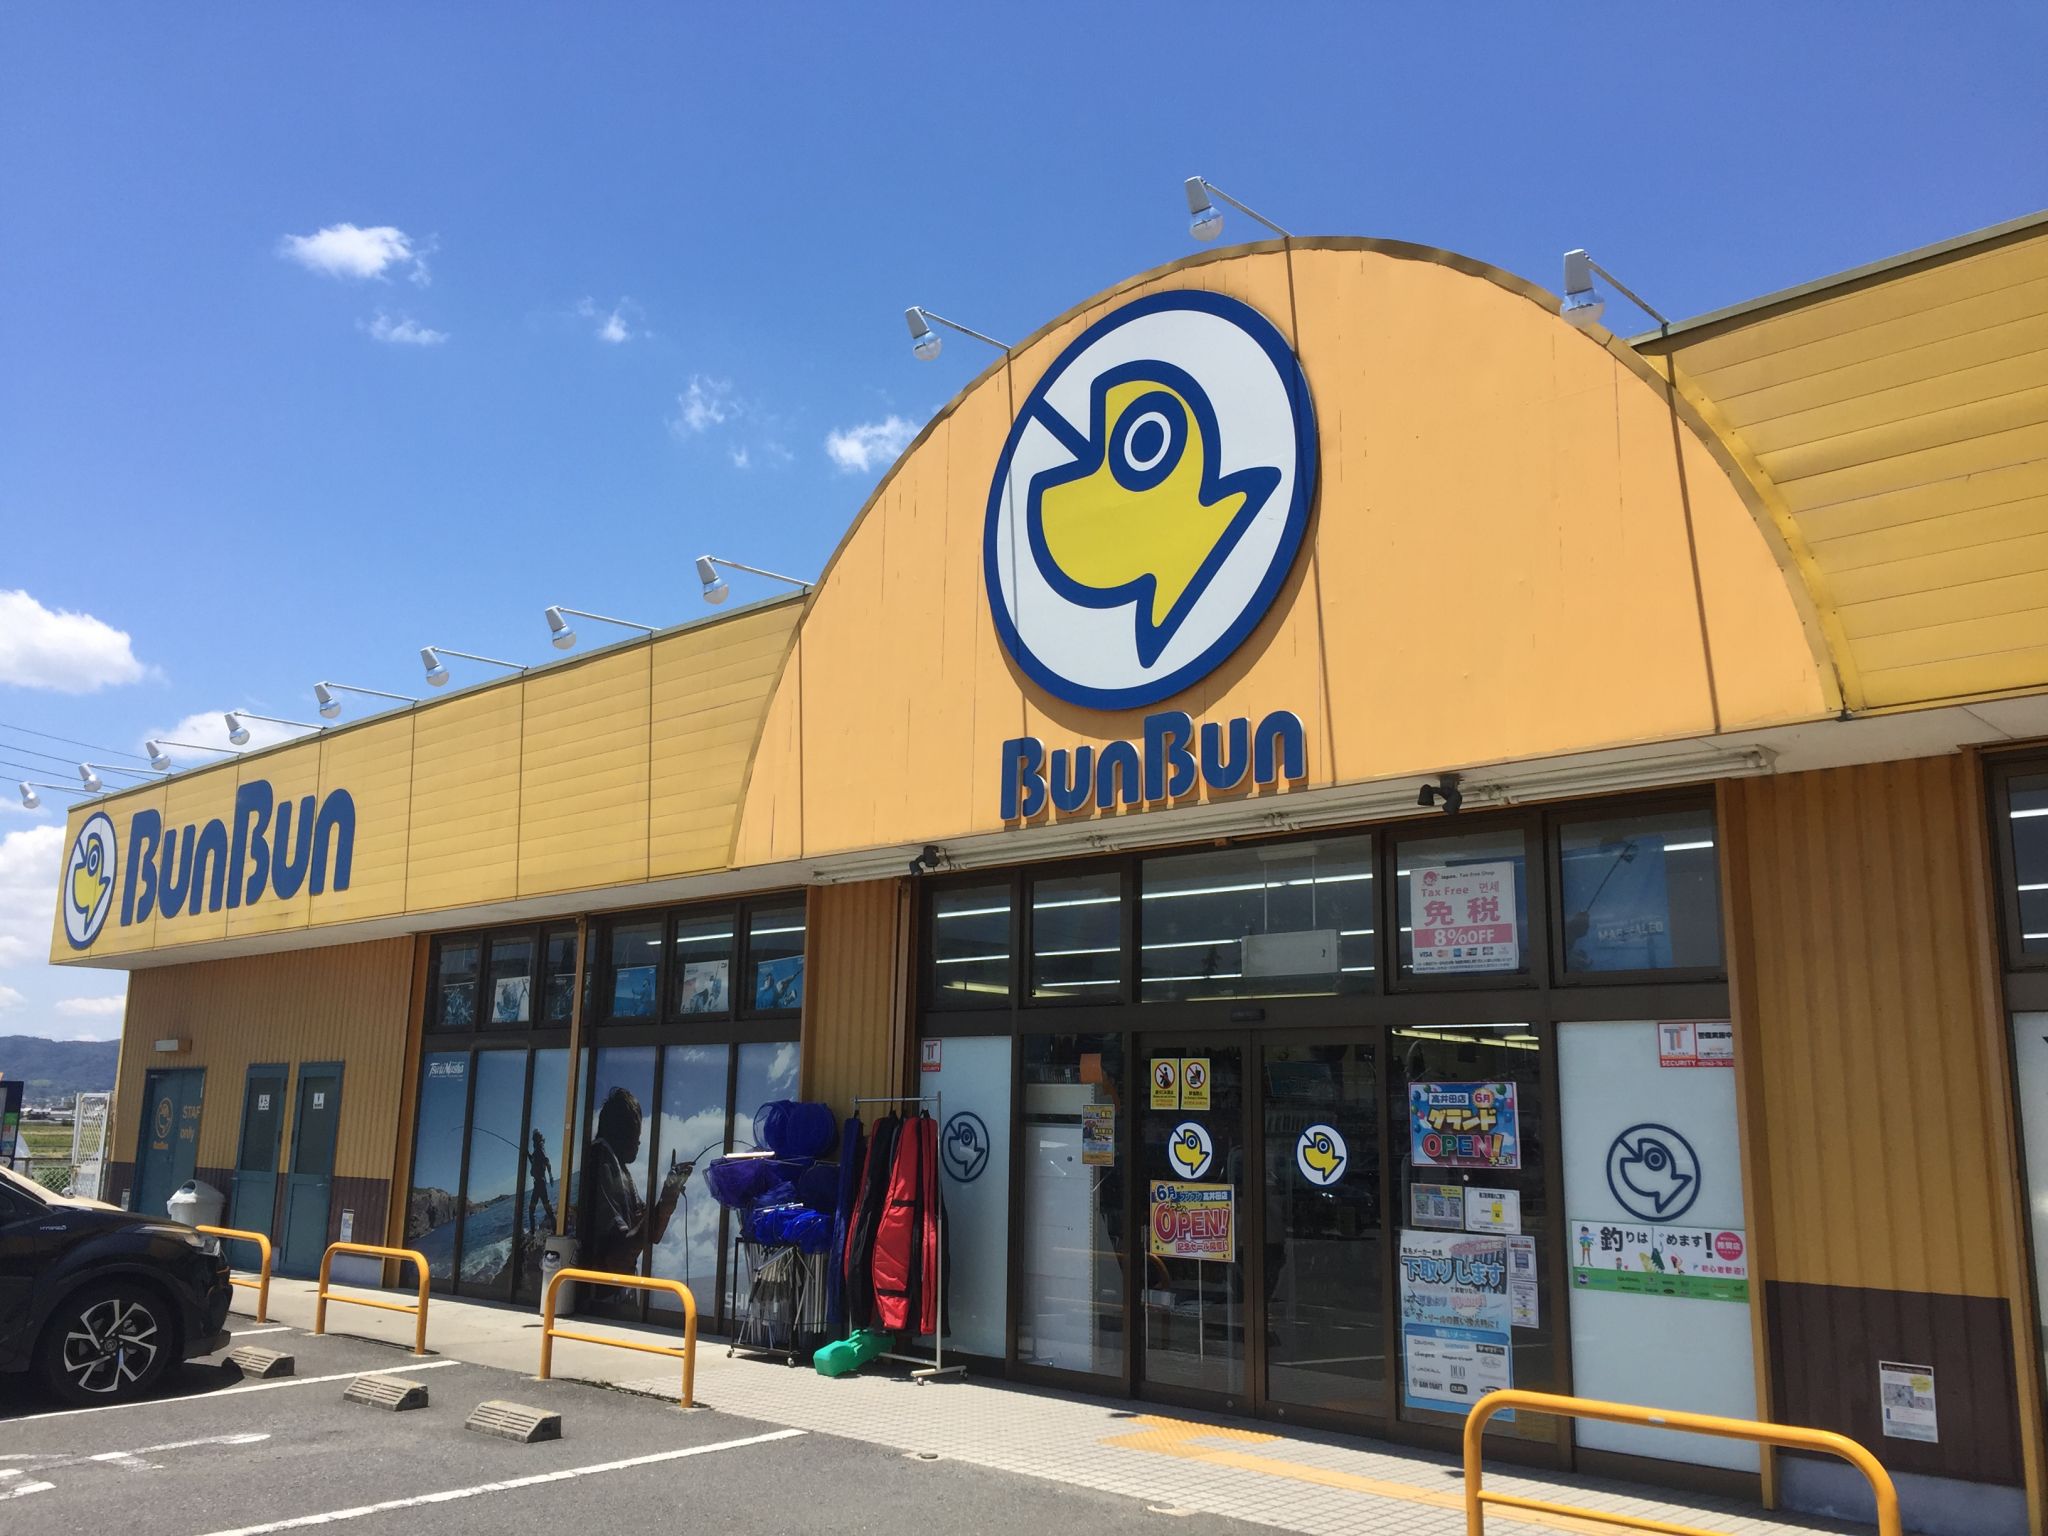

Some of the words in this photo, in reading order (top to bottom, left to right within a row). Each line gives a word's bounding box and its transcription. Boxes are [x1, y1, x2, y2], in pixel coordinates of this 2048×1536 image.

[1421, 888, 1441, 897] Tax
[1444, 886, 1469, 896] Free
[1434, 928, 1495, 946] 8%OFF
[1475, 1092, 1491, 1104] 6月
[1428, 1108, 1497, 1131] グランド
[1423, 1133, 1503, 1158] OPEN!
[1156, 1184, 1177, 1201] 6月
[1401, 1255, 1505, 1288] 下取りします
